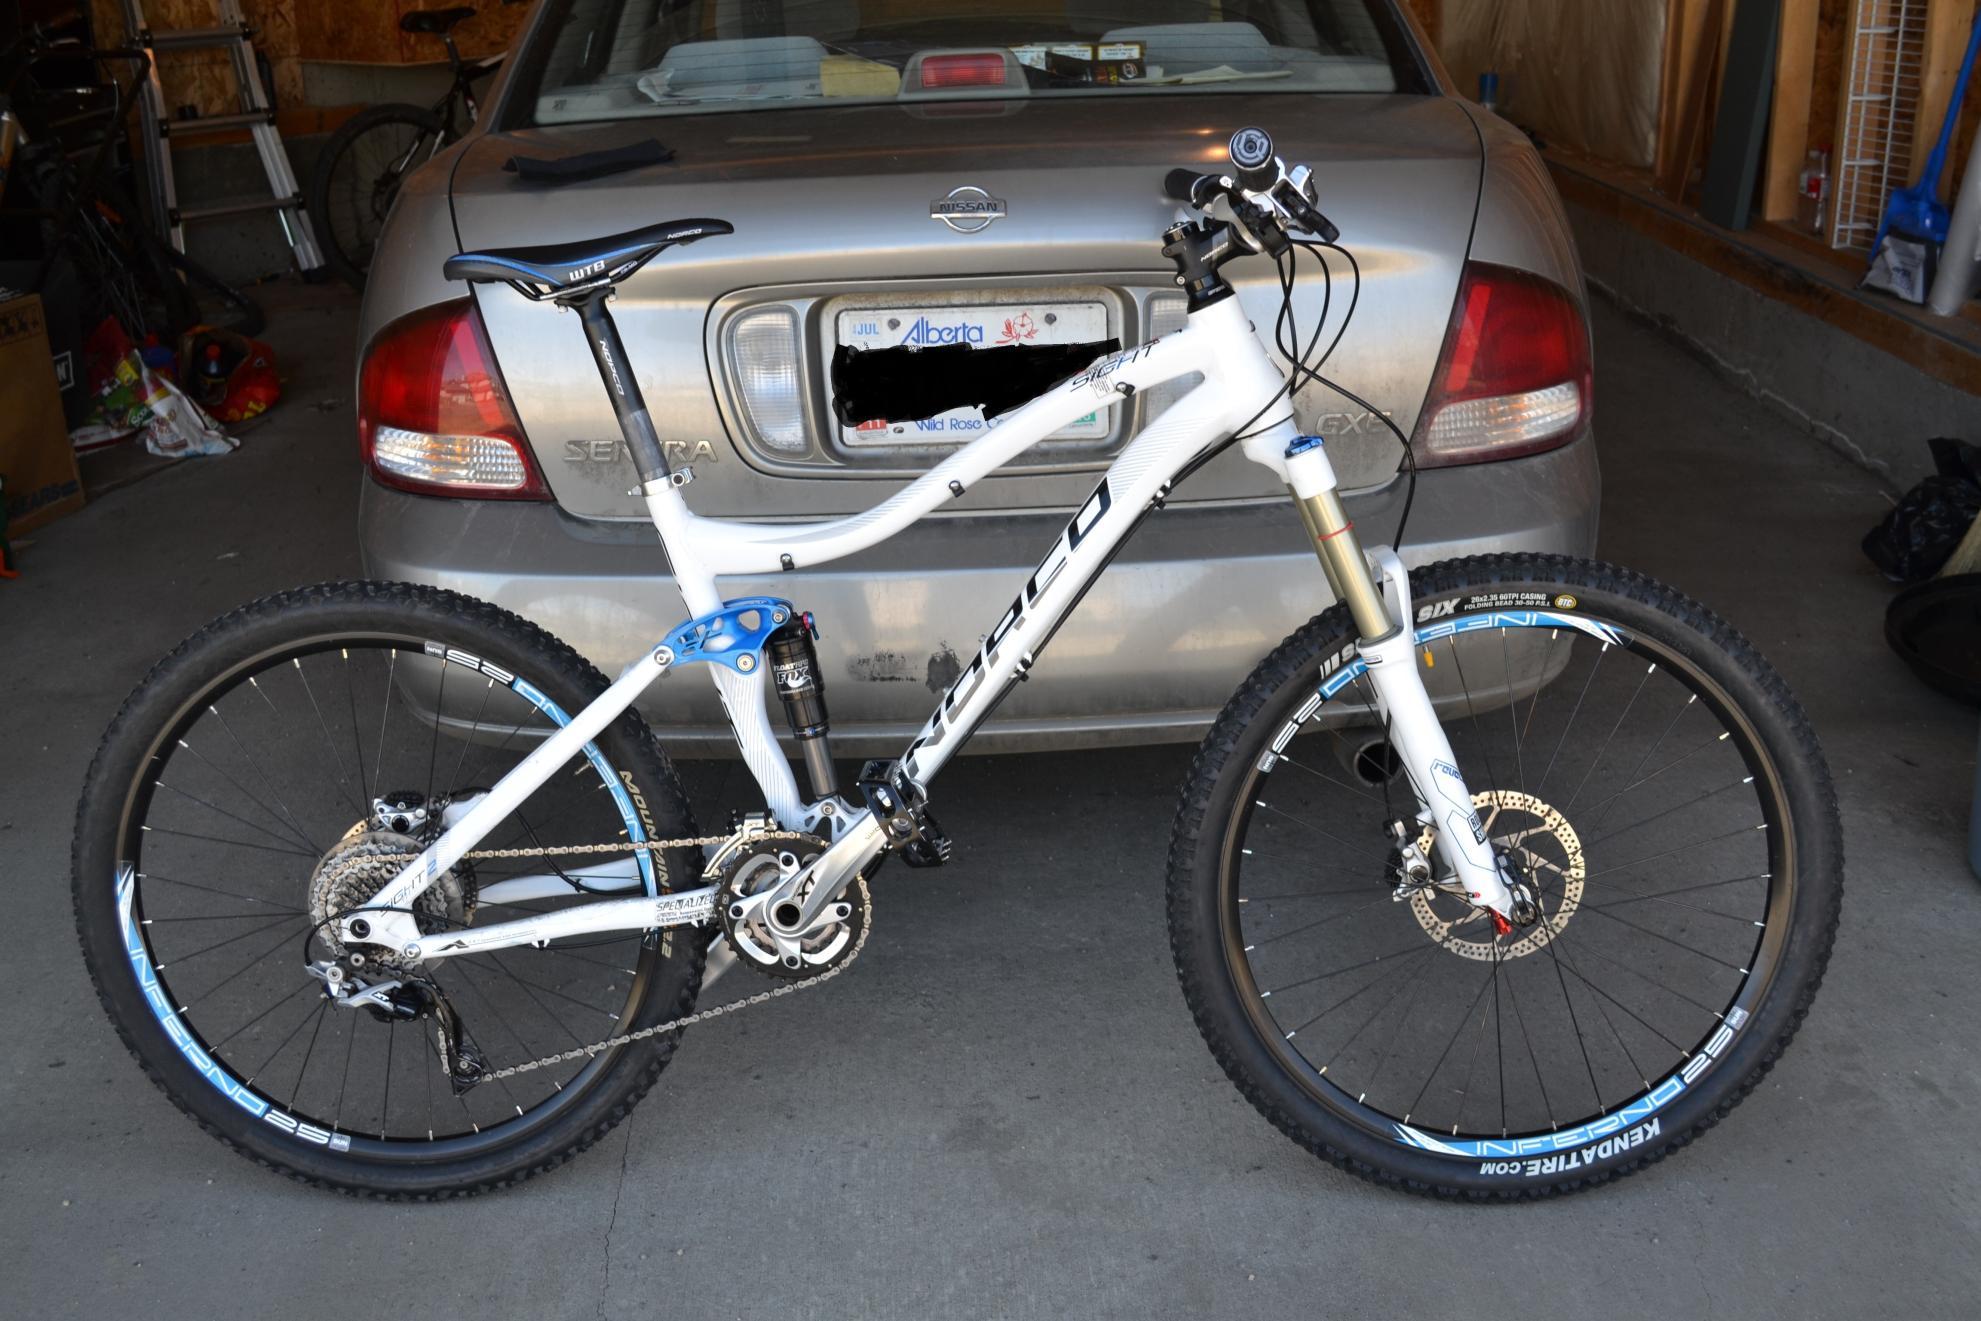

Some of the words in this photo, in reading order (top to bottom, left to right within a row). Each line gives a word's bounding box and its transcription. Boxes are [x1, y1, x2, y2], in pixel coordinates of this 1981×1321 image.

[940, 202, 997, 212] NISSAN
[667, 228, 702, 240] NORCO
[569, 259, 606, 281] WTB
[857, 322, 880, 336] JUL
[900, 316, 983, 345] Alberta
[599, 338, 626, 396] NORCO
[1070, 339, 1159, 392] SIGHT
[915, 417, 944, 431] Wild
[950, 418, 982, 430] Rose
[1316, 411, 1392, 435] GXE
[563, 440, 719, 463] SENRA
[1464, 600, 1493, 611] FOLDING
[1520, 592, 1547, 600] CASING
[1417, 597, 1461, 623] SIX
[905, 477, 1112, 778] NORCO
[446, 649, 515, 685] 25
[380, 869, 426, 917] SIGHT
[797, 869, 816, 905] XT
[130, 947, 266, 1117] INFERNO
[264, 1109, 331, 1145] 25
[1477, 1079, 1682, 1156] INFERNO
[1681, 1025, 1733, 1084] 25
[1480, 1117, 1661, 1177] KENDATIRE.COM
